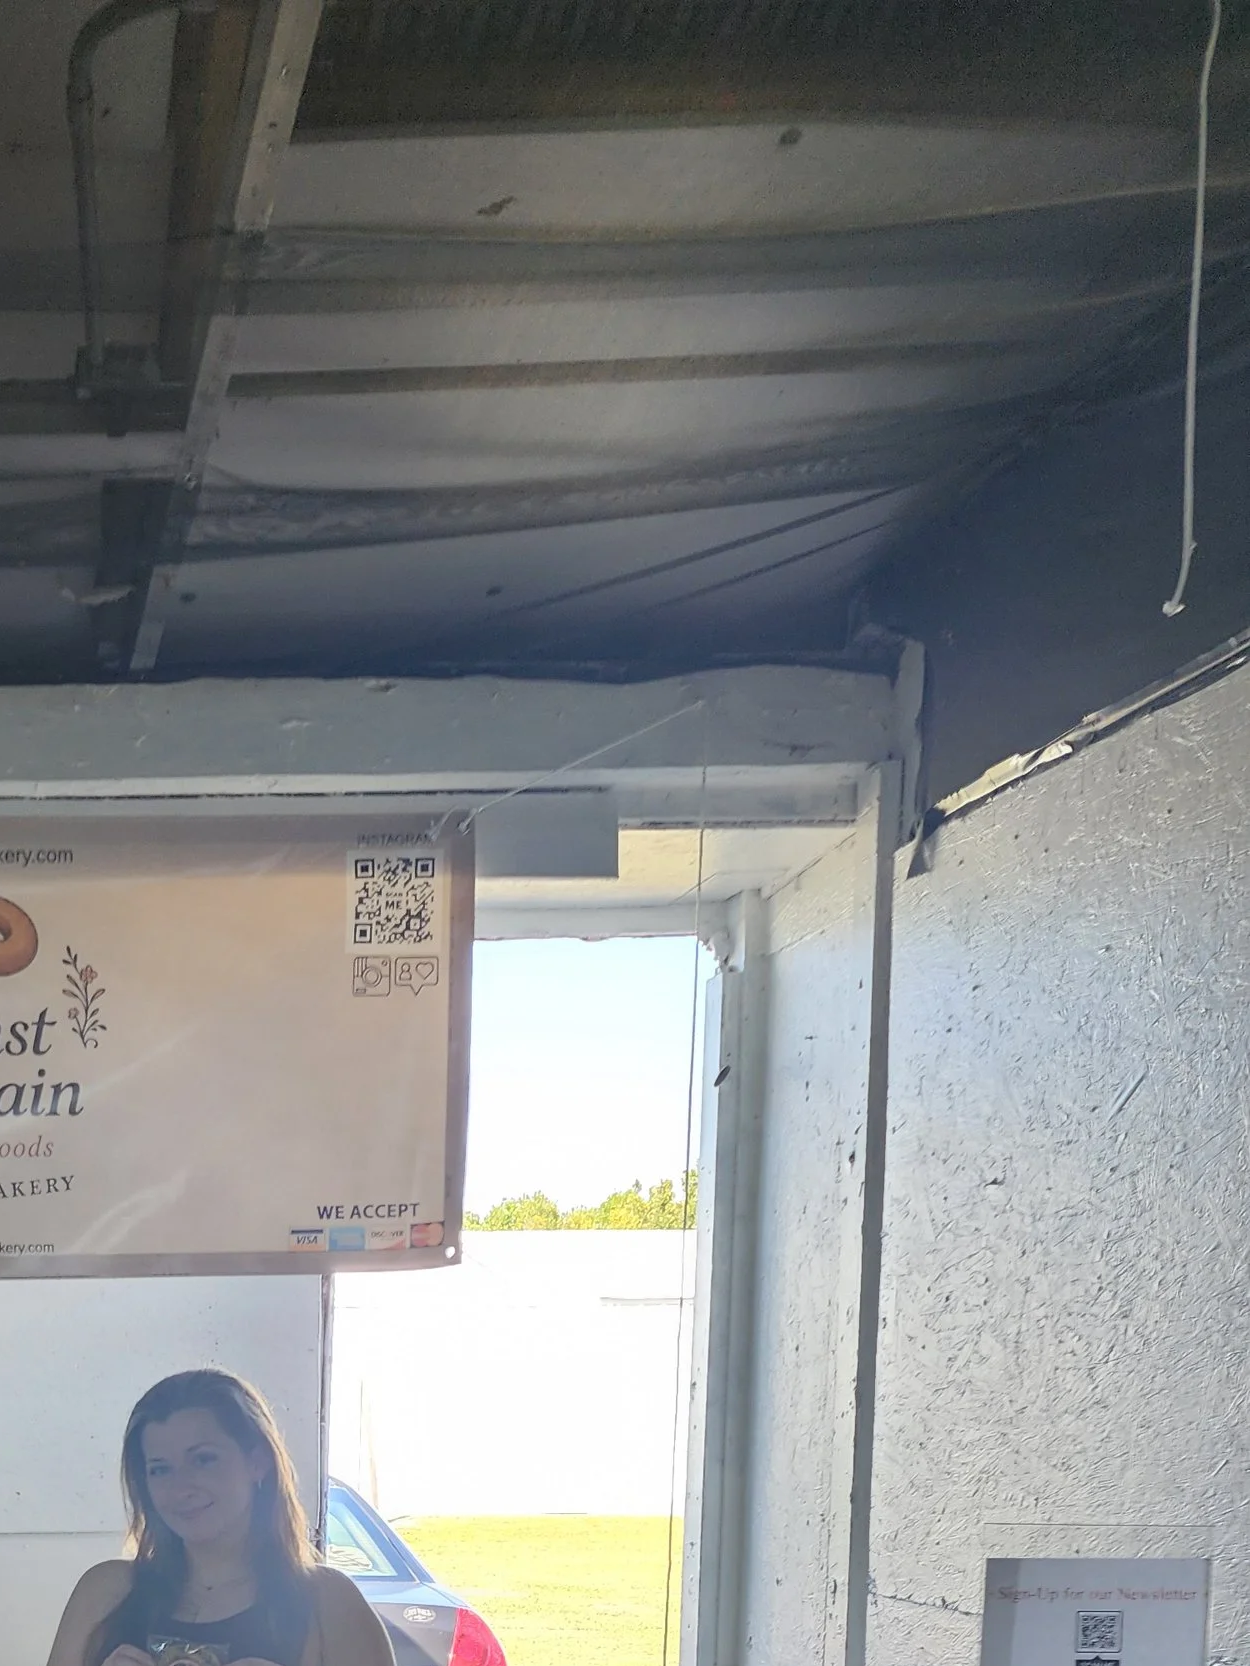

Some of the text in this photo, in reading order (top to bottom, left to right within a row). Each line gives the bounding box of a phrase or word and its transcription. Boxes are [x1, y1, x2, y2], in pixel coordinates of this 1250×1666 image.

[317, 1202, 420, 1220] WE ACCEPT
[296, 1236, 318, 1245] VISA
[998, 1586, 1059, 1603] Sign-Up
[1064, 1586, 1085, 1601] for
[1116, 1587, 1198, 1601] Newsletter
